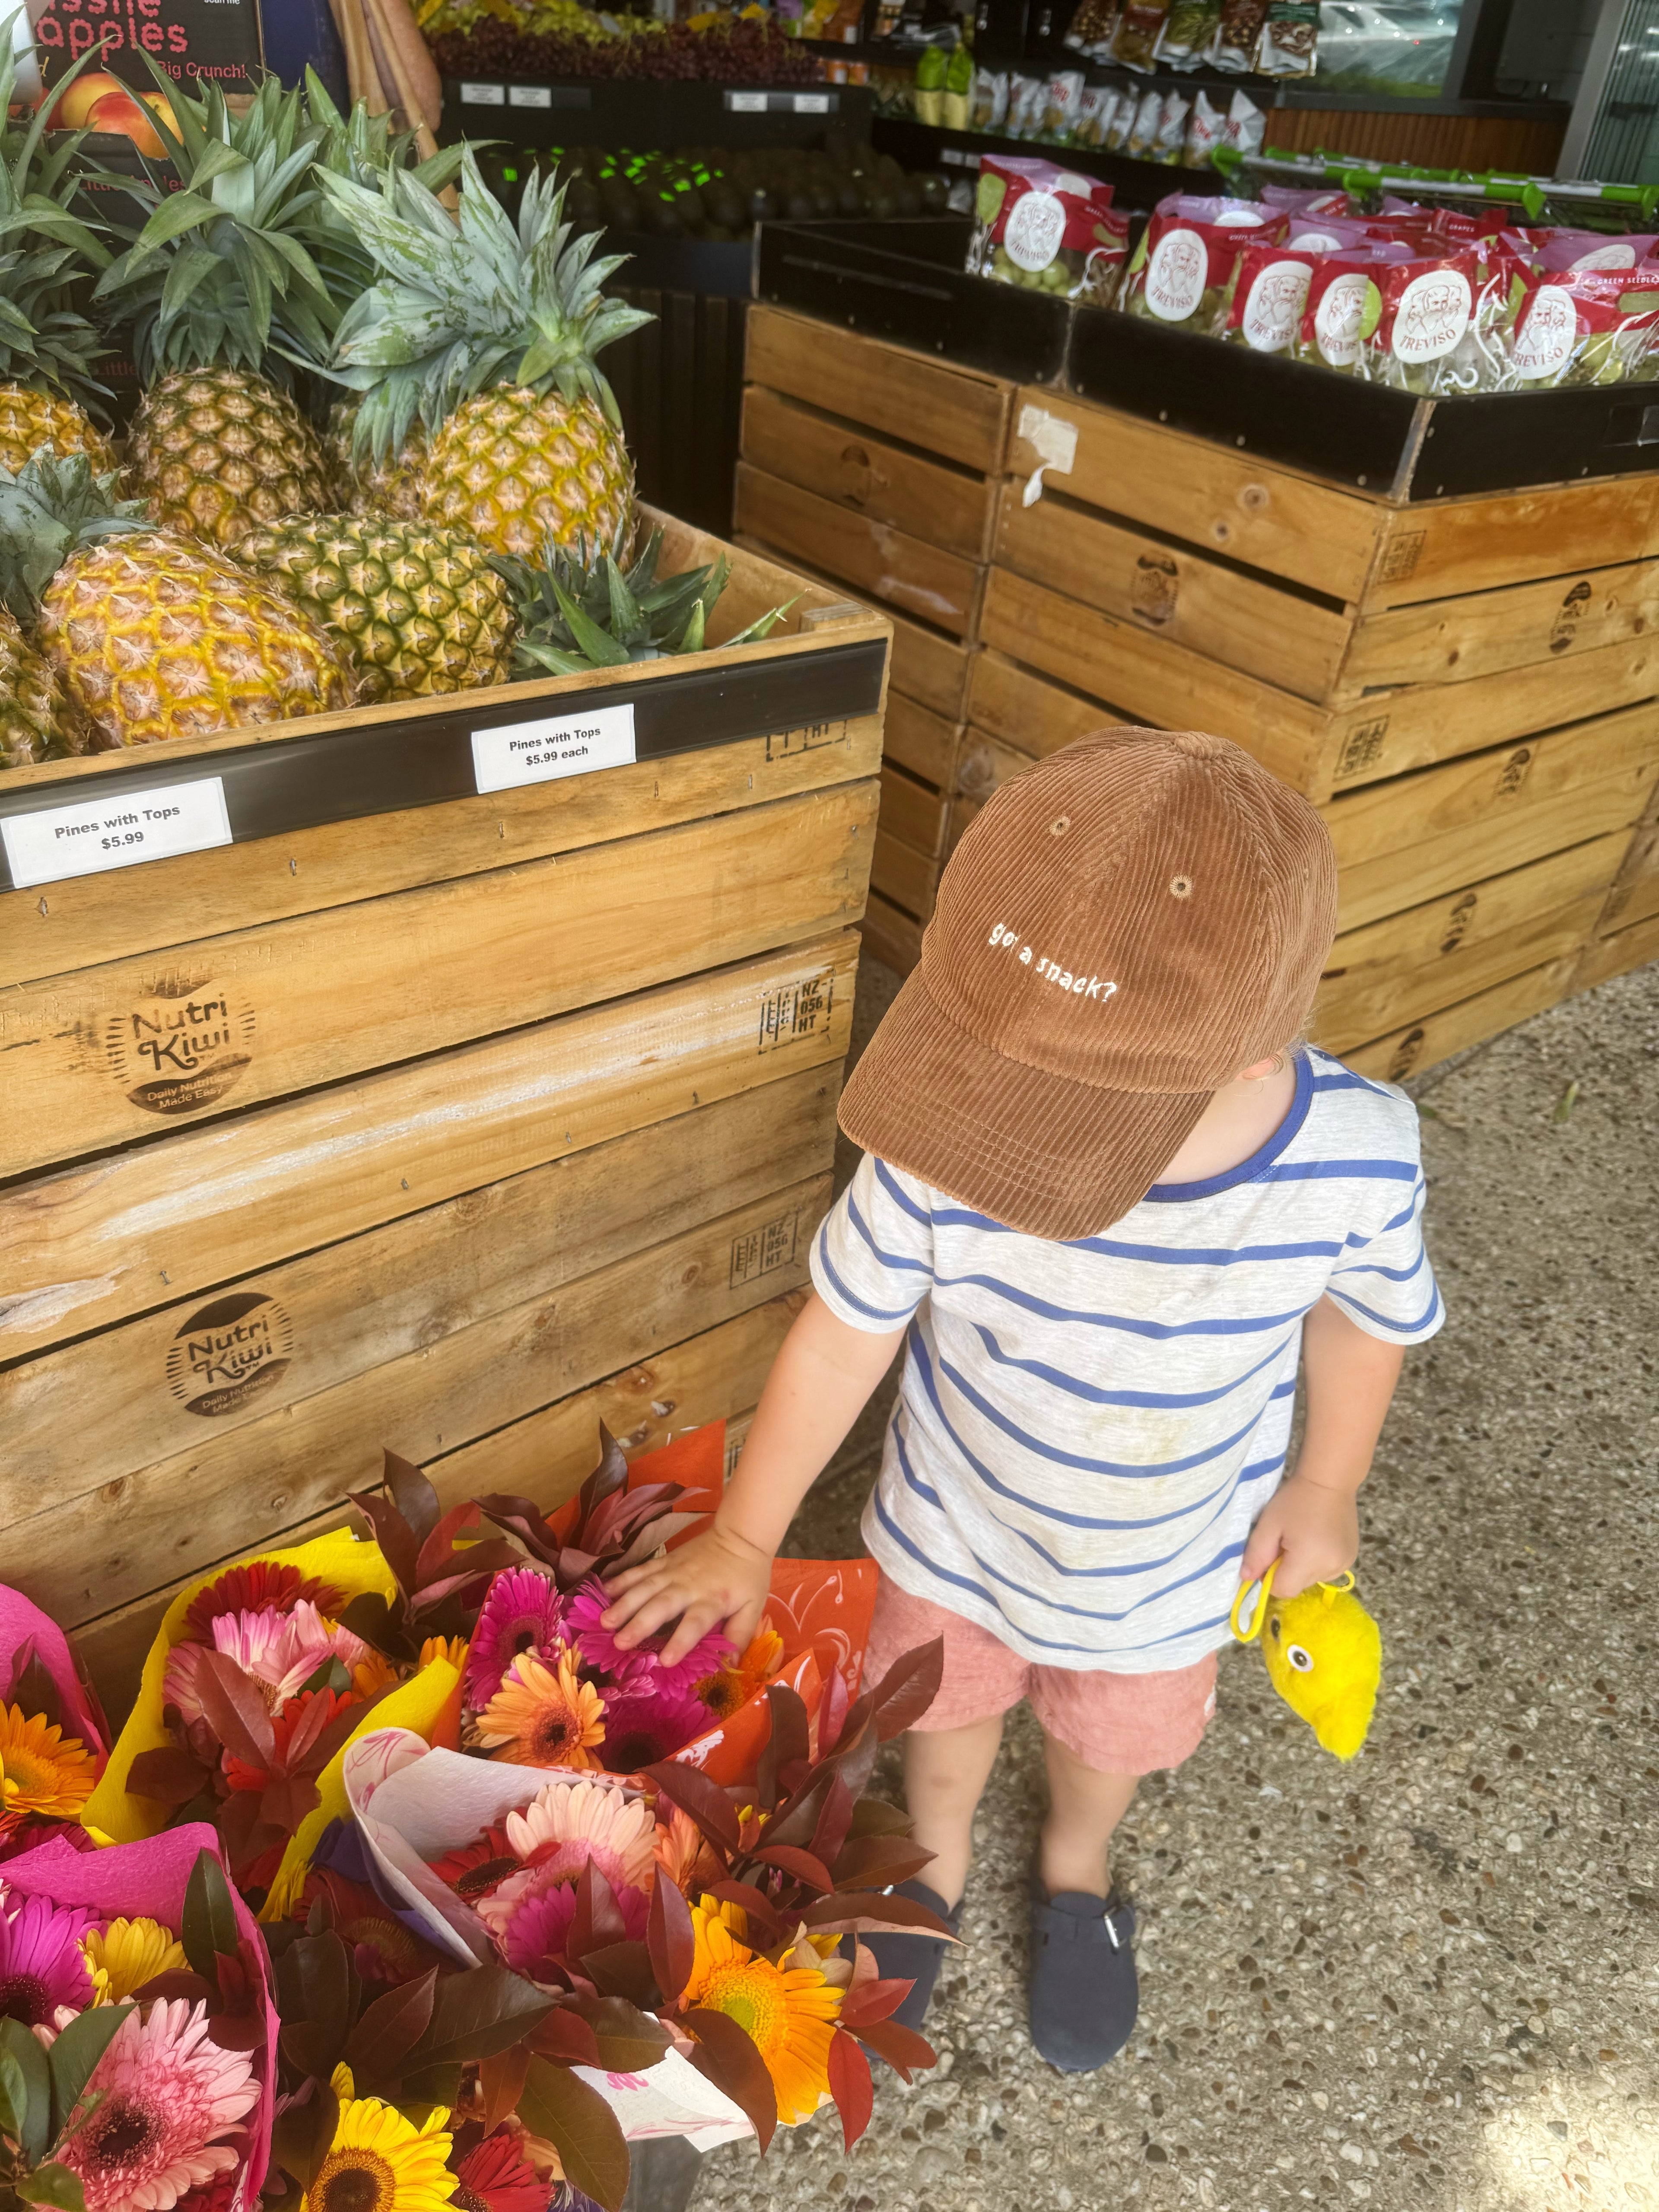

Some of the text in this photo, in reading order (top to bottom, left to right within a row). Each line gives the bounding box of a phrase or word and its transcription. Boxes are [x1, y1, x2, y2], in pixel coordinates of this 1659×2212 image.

[37, 16, 188, 62] apples
[186, 62, 246, 79] Crunch!
[1400, 329, 1456, 351] TREVISO
[509, 727, 601, 752] Pines with Tops
[526, 746, 588, 766] $5.99 each
[54, 806, 181, 839] Pines with Tops
[101, 831, 144, 851] $5.99
[1019, 946, 1033, 965] a
[1036, 958, 1117, 1002] snack?
[132, 993, 228, 1039] Nutri
[800, 995, 823, 1014] 056
[798, 1014, 817, 1033] HT
[137, 1022, 230, 1071] Kiwi
[147, 1072, 232, 1102] Daily Nutrition
[158, 1084, 223, 1109] Made Easy
[766, 1249, 782, 1267] HT
[188, 1314, 269, 1361] Nutri
[192, 1337, 273, 1383] Kiwi
[202, 1395, 228, 1409] Daily
